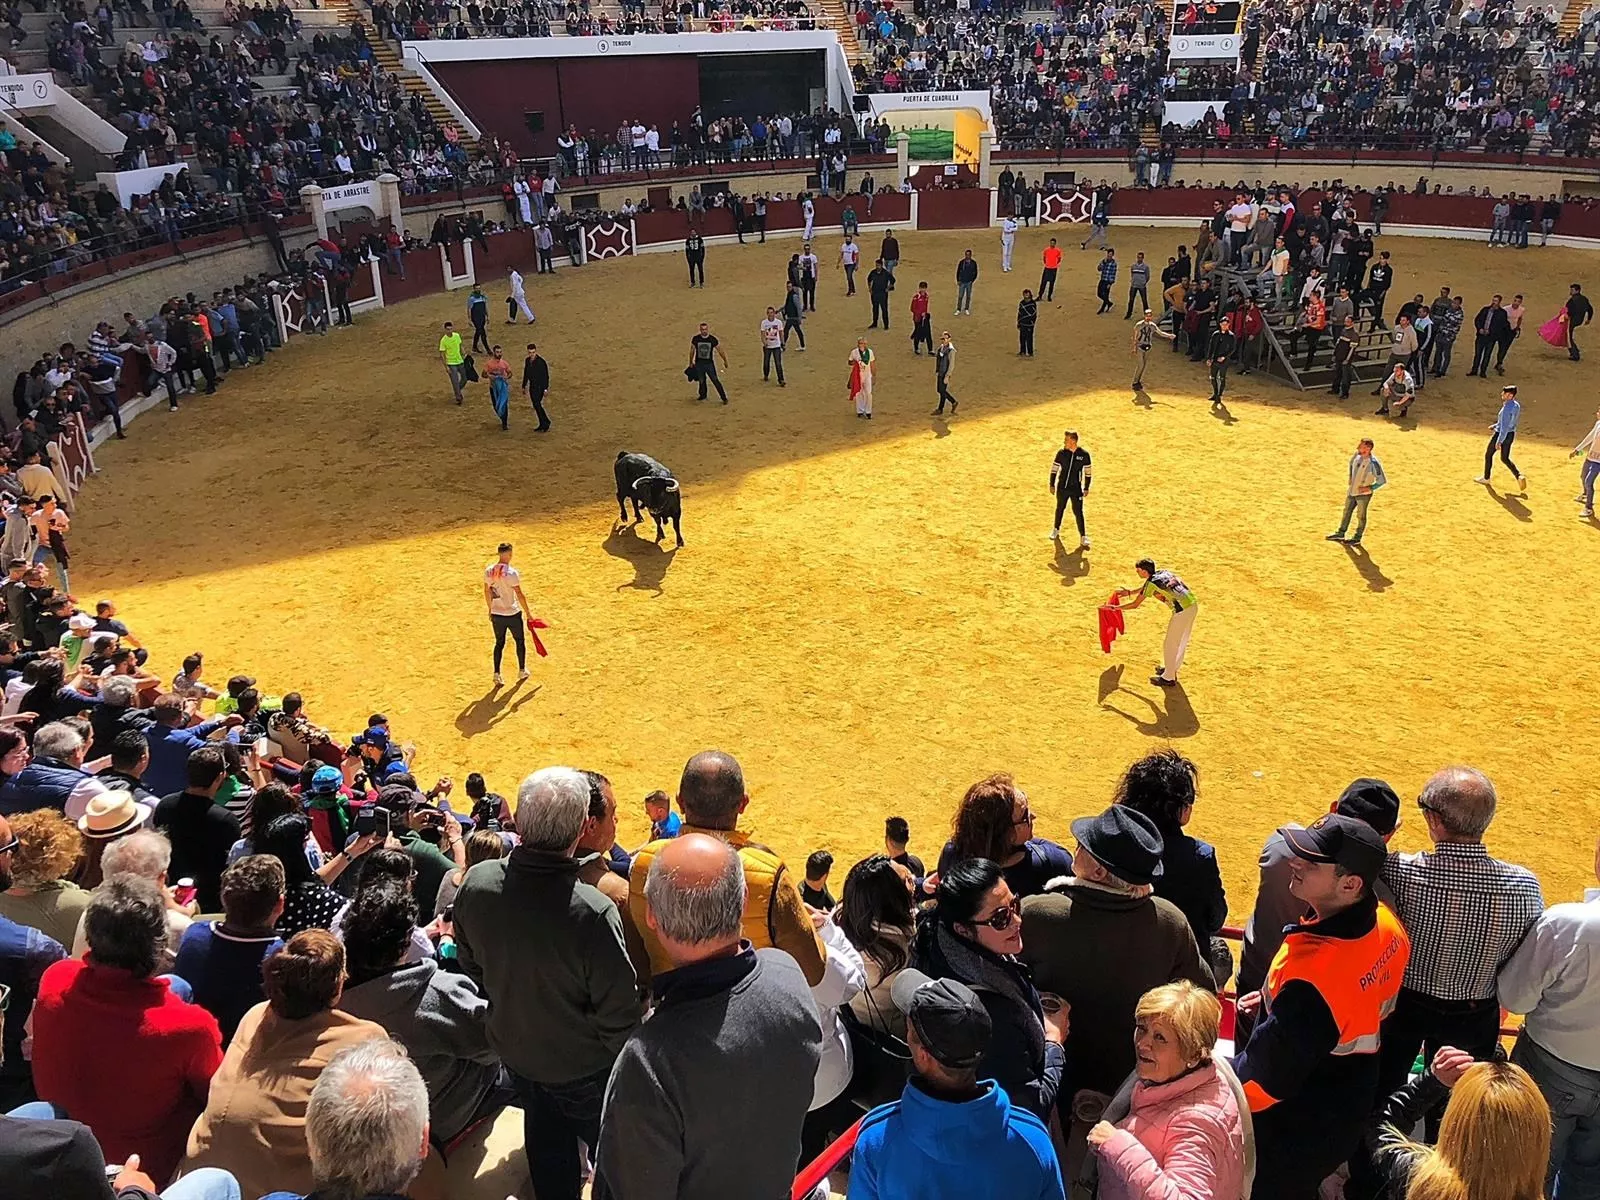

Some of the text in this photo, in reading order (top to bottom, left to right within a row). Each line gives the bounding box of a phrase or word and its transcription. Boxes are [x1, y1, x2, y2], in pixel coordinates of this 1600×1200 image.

[0, 84, 24, 92] TENDIDO
[931, 94, 959, 102] CUADRILLA
[321, 186, 370, 200] RTA DE ARRASTRE
[1378, 969, 1391, 985] VIL
